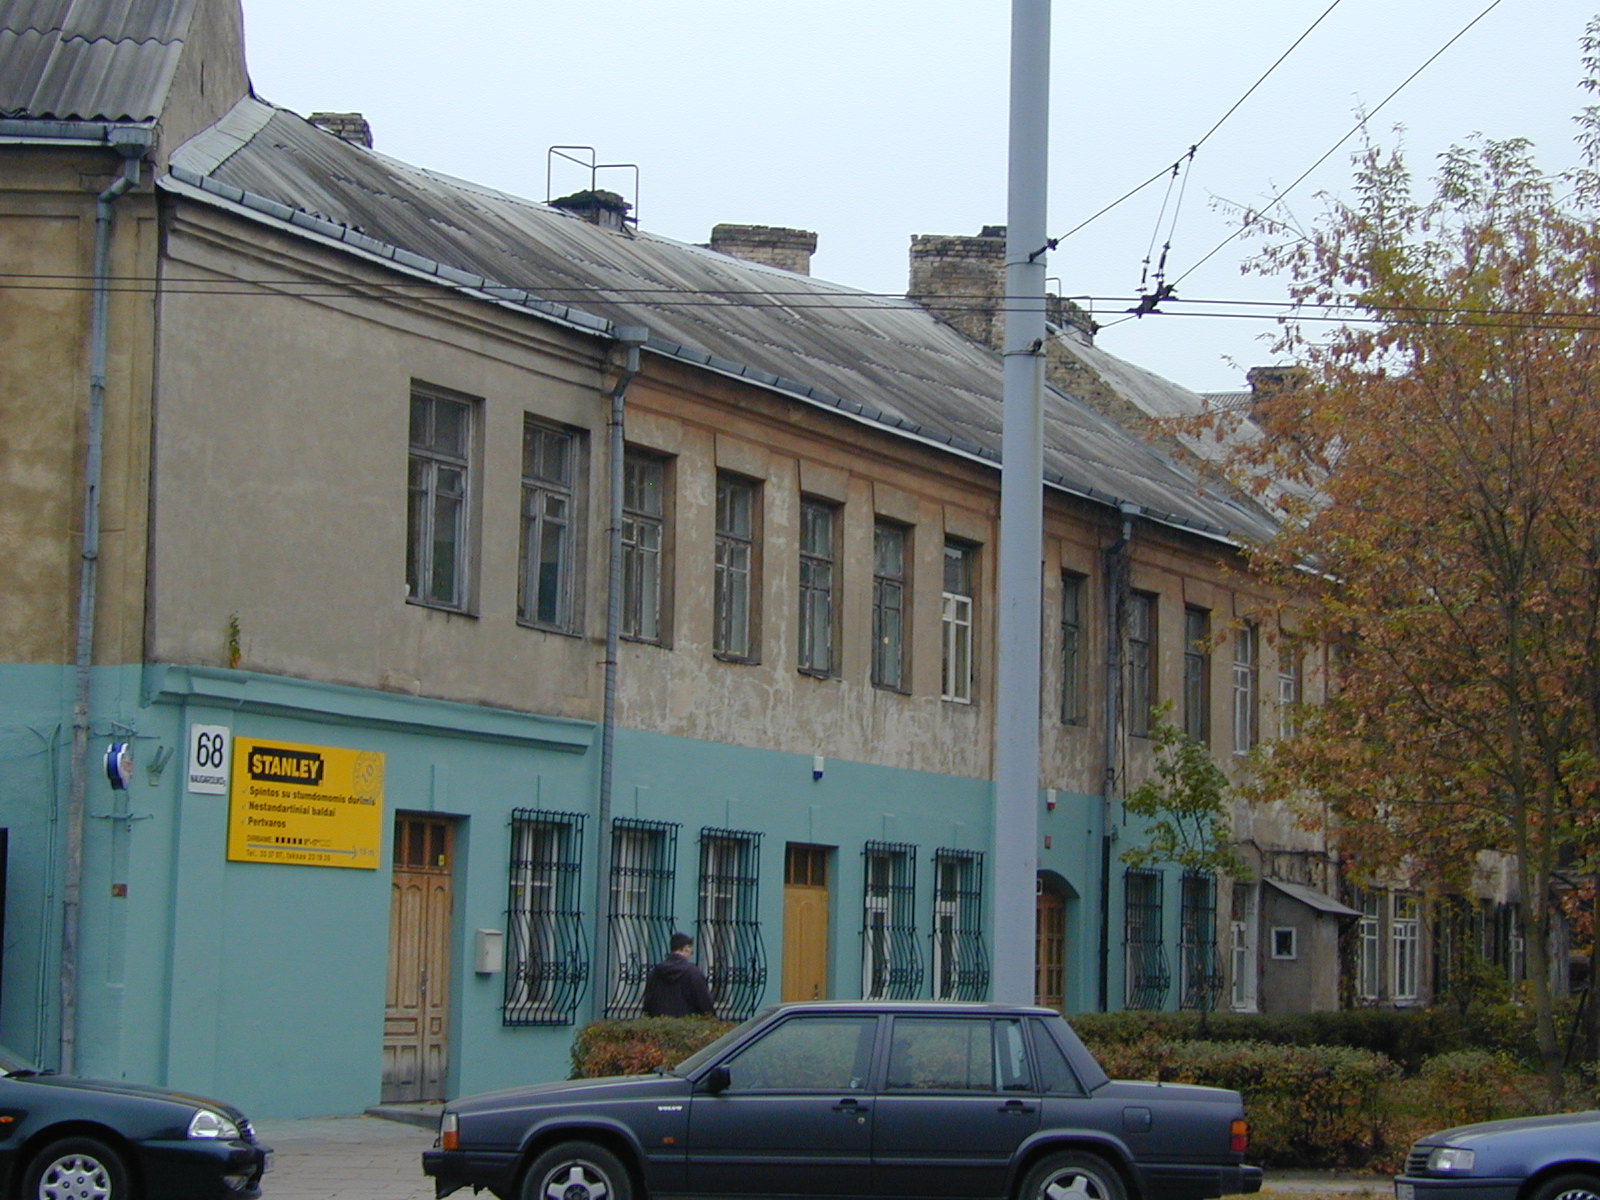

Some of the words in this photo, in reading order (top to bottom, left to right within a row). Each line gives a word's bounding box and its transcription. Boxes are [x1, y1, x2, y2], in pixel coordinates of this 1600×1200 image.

[197, 732, 224, 769] 68
[251, 754, 320, 779] STANLEY
[249, 786, 279, 798] Spintos
[281, 790, 291, 799] su
[293, 791, 346, 804] stumdomomis
[347, 796, 376, 806] durimis
[248, 801, 311, 816] Nestandartiniai
[311, 807, 337, 817] baldai
[247, 816, 287, 829] Pertvaros
